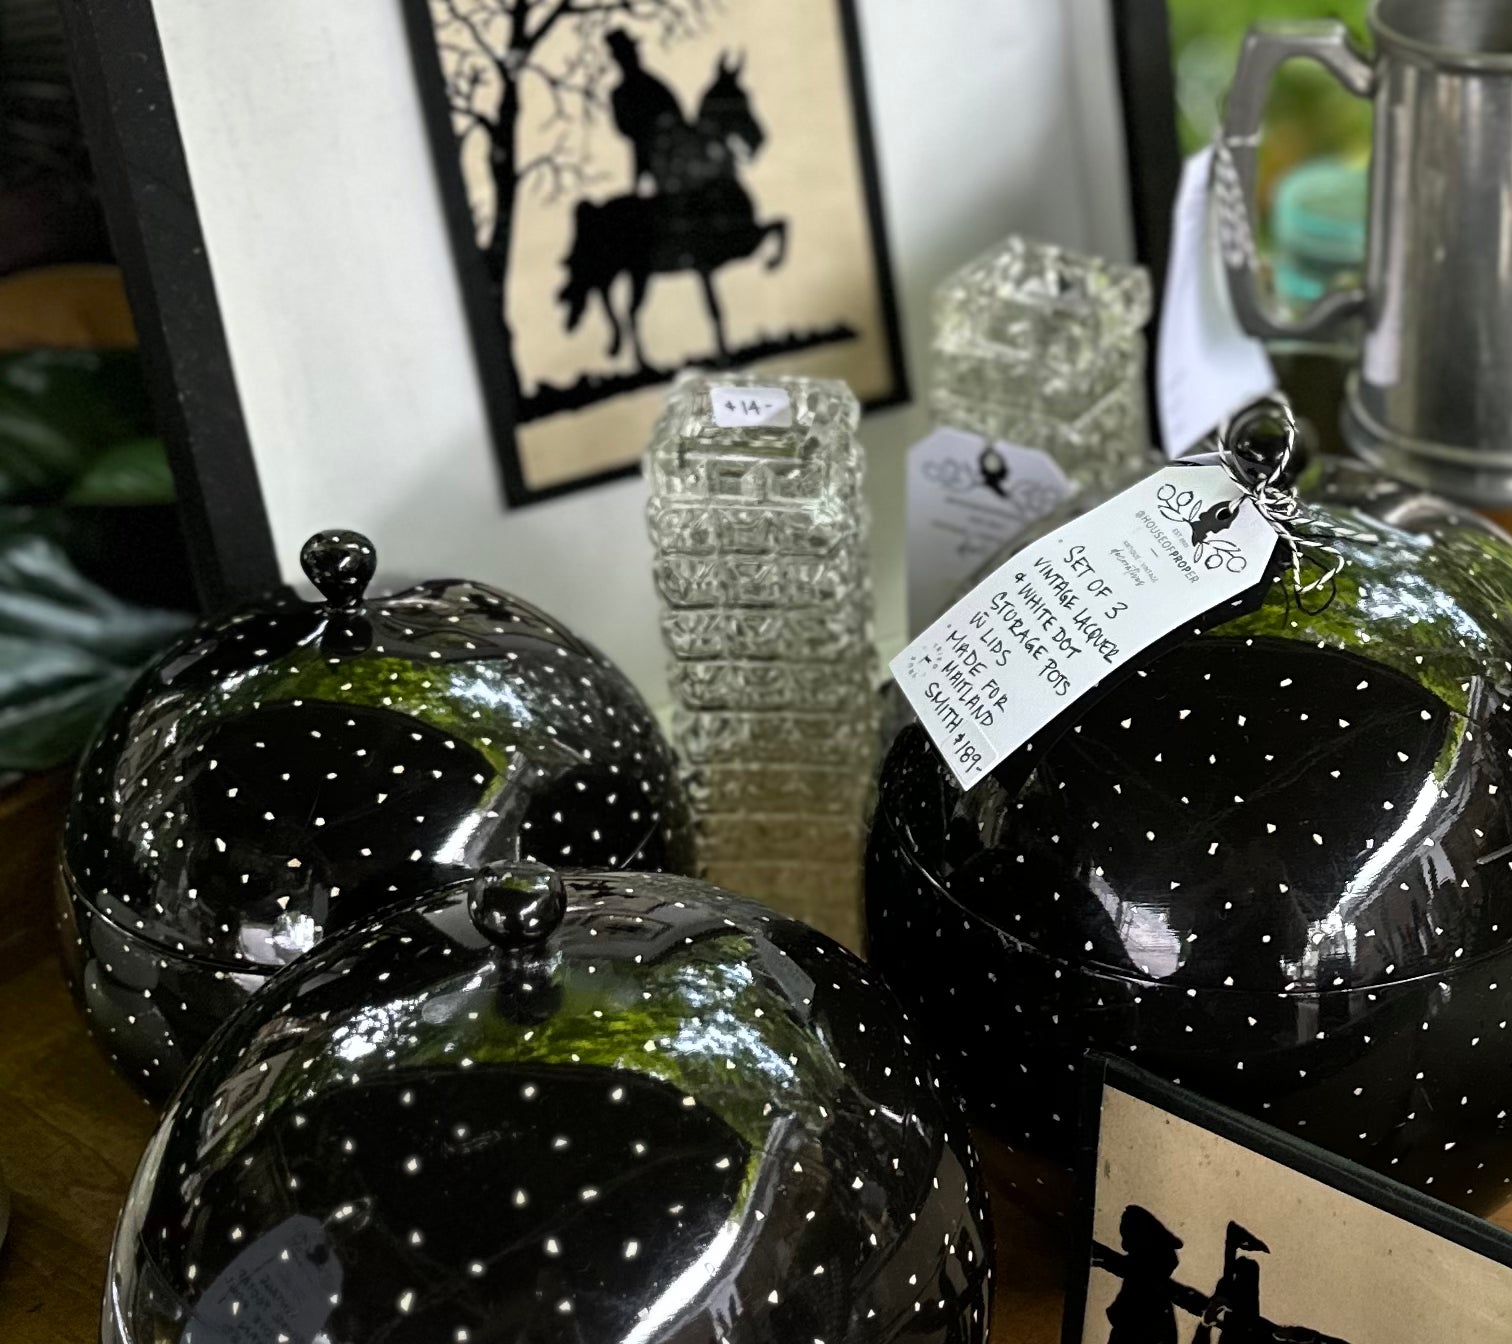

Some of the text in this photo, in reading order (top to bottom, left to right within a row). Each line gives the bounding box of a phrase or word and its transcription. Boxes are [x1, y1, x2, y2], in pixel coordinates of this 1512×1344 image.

[1034, 557, 1119, 664] VINTAGE LACQUER
[1064, 545, 1128, 619] SET OF 3
[980, 628, 1012, 666] LIDS
[991, 592, 1071, 696] STORAGE POTS
[1018, 582, 1057, 631] WHITE
[1052, 627, 1082, 658] DOT
[925, 682, 963, 733] SMITH
[941, 660, 994, 726] MAITLAND
[946, 629, 1008, 713] MADE FOR
